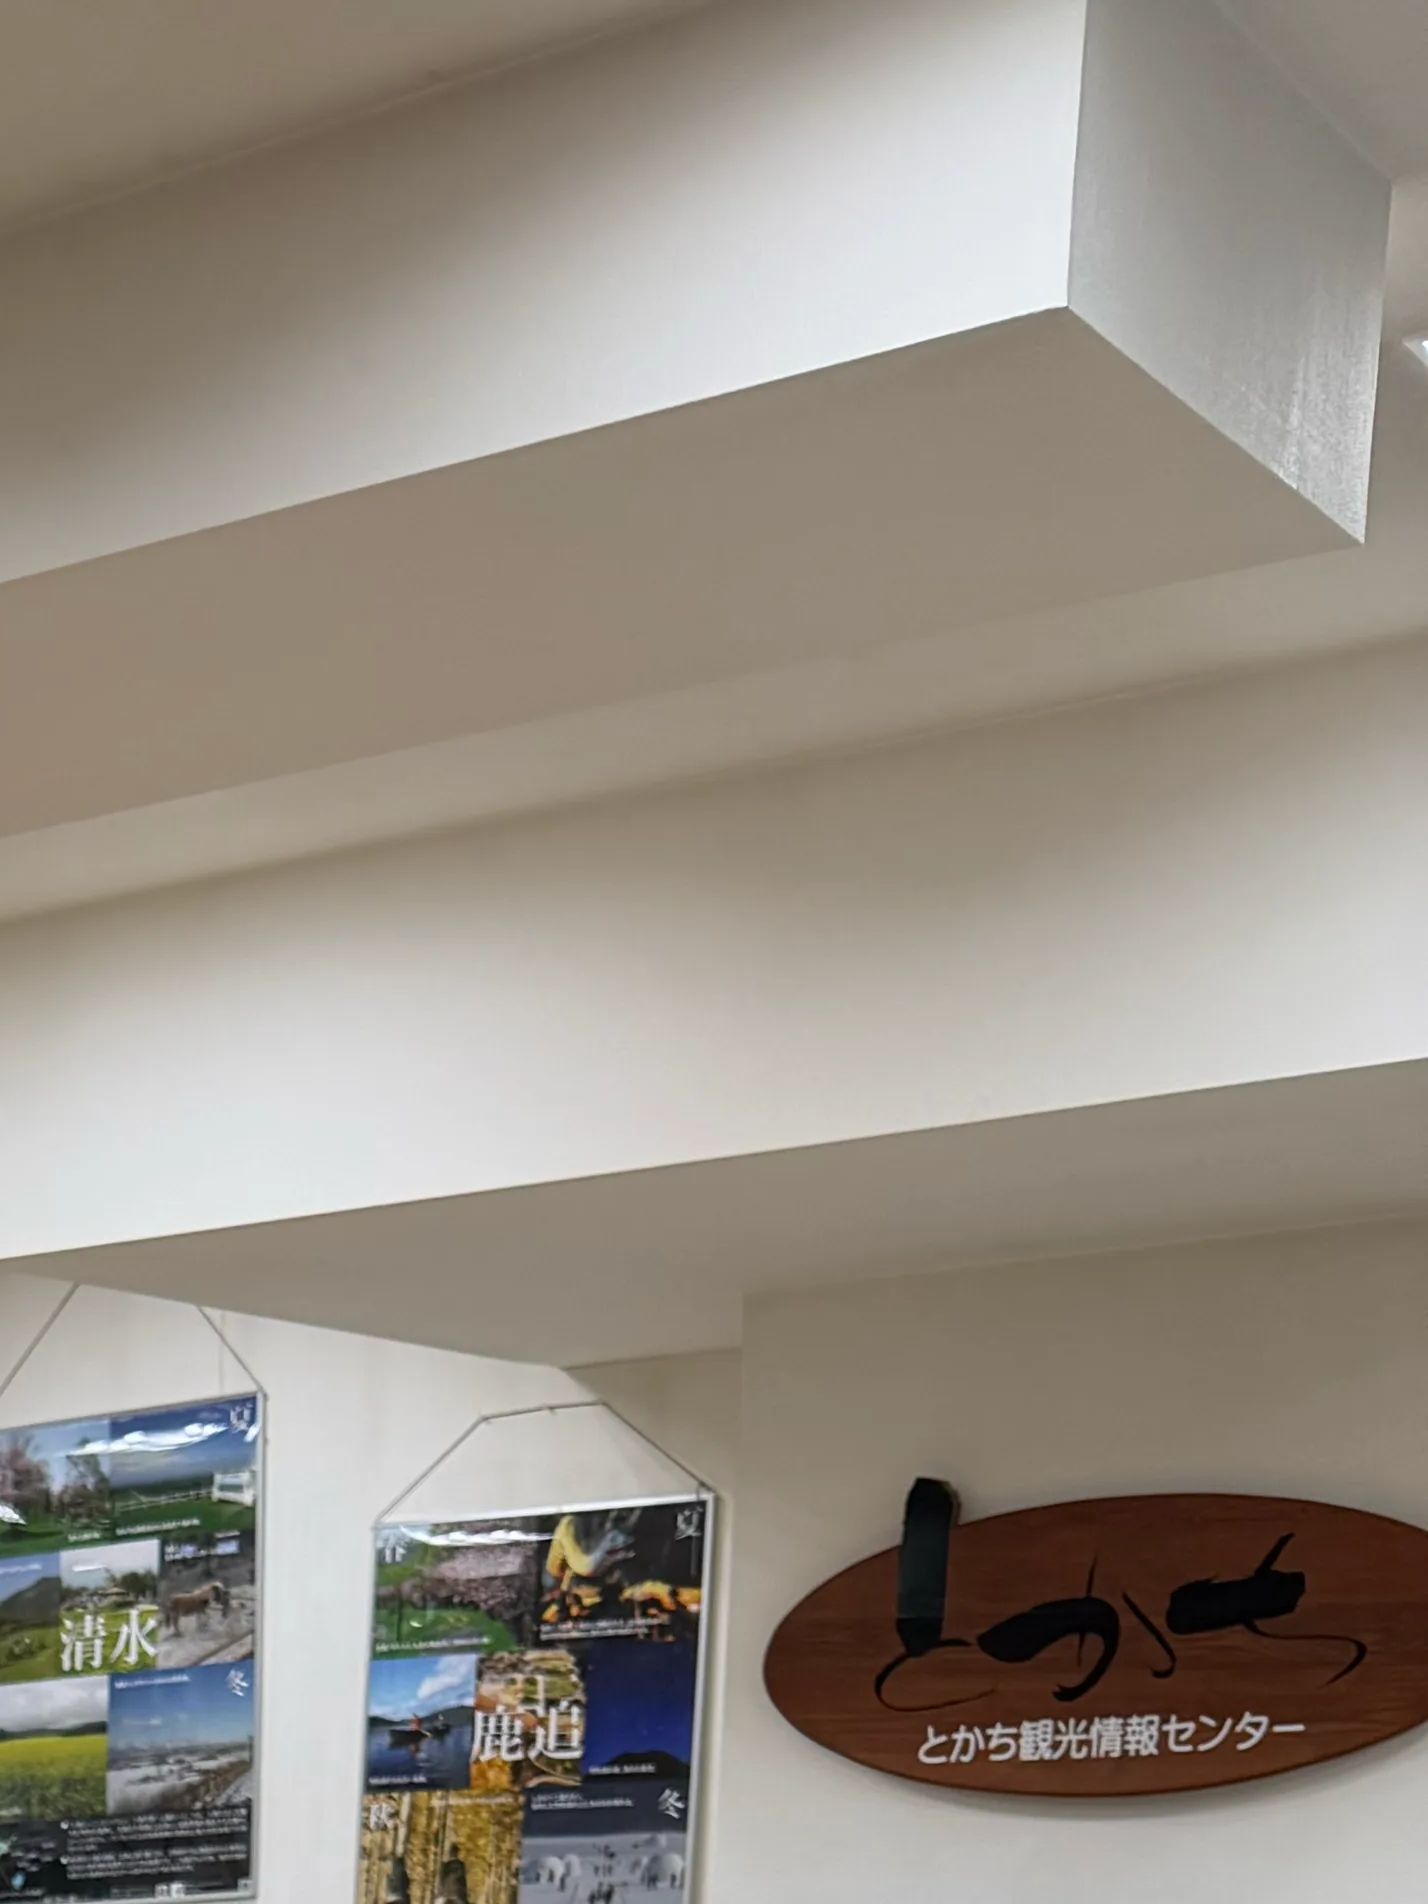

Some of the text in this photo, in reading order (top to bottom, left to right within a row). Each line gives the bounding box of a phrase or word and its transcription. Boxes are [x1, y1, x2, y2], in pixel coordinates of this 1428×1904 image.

[60, 1607, 159, 1673] 清水
[471, 1689, 585, 1767] 鹿追
[917, 1710, 1305, 1765] とかち観光情報センター
